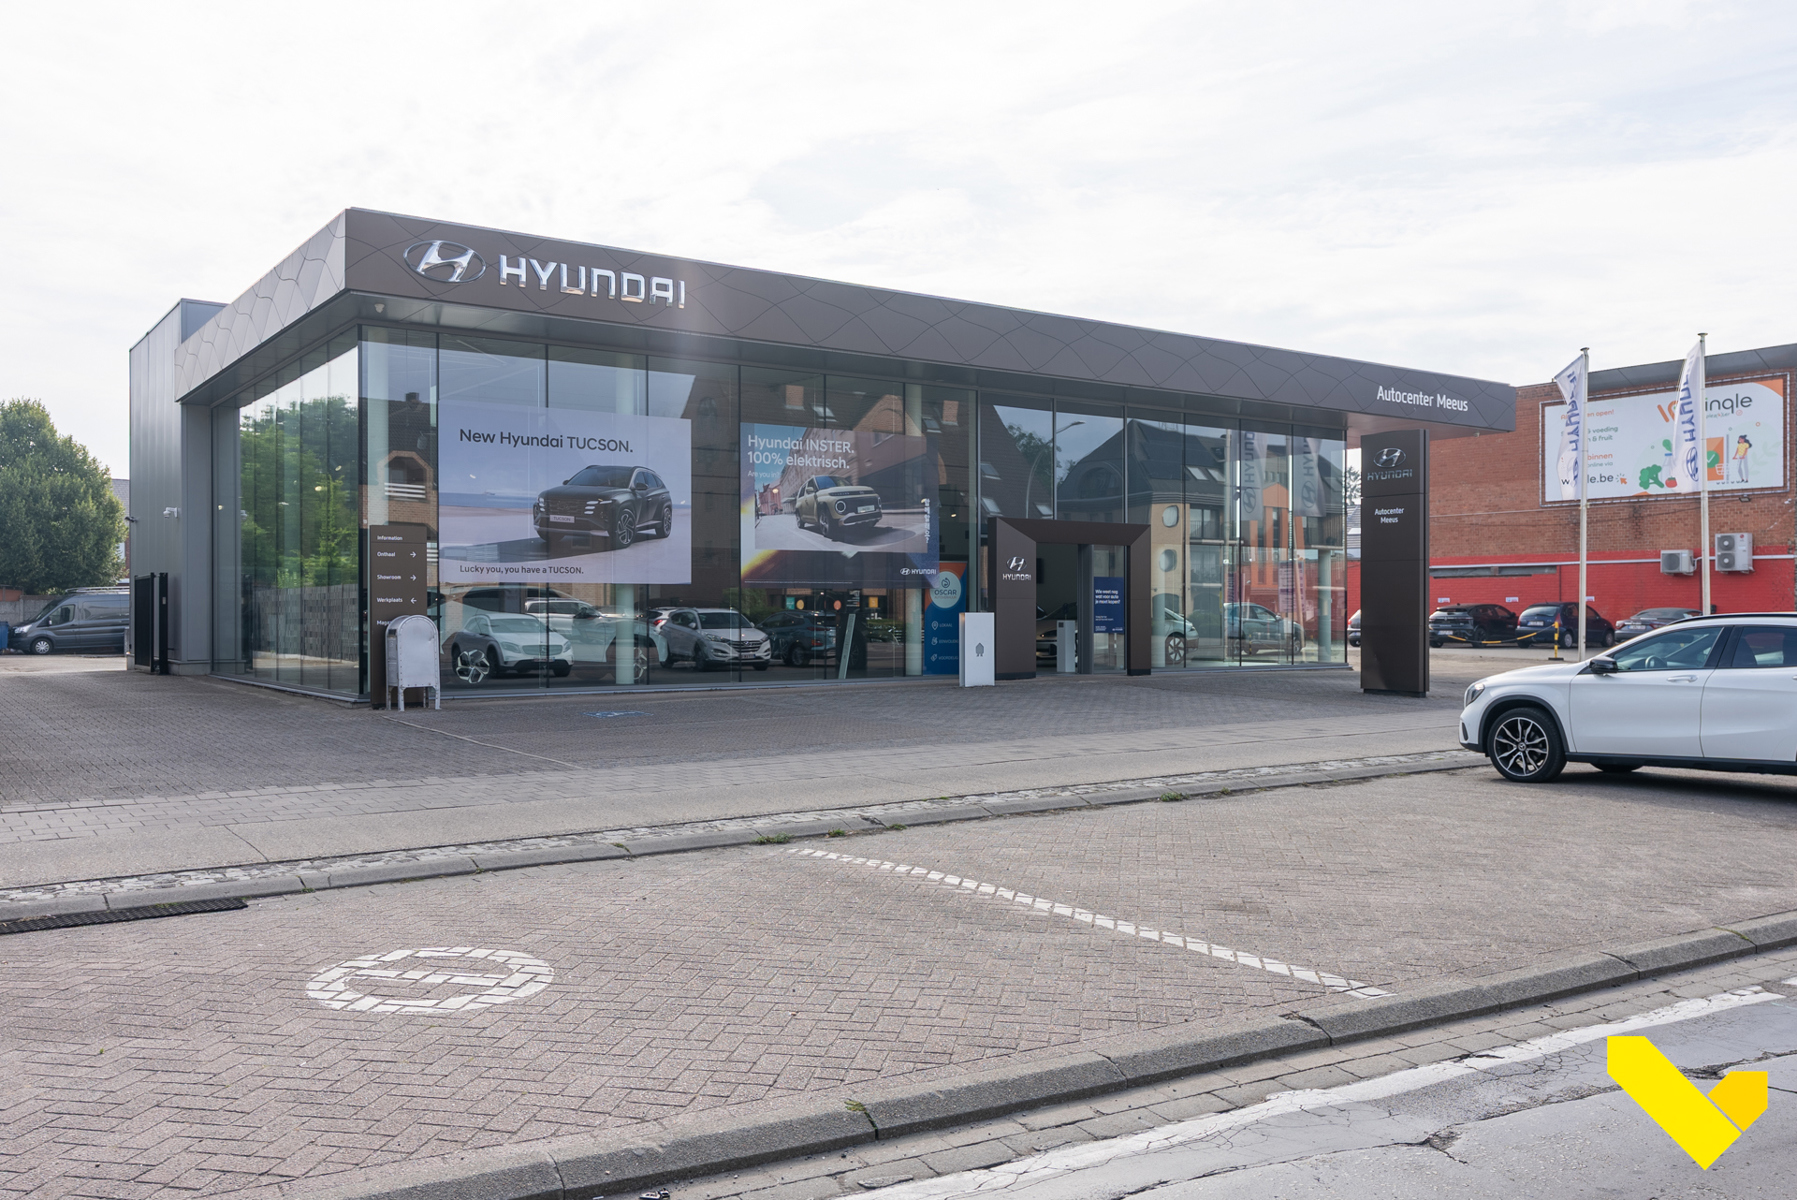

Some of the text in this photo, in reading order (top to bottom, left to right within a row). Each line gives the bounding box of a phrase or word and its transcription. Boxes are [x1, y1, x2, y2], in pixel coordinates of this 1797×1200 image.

[499, 254, 685, 309] HYUNDAI
[1377, 385, 1469, 412] Autocenter Meeus
[459, 428, 634, 453] New Hyundai TUCSON.
[747, 435, 855, 454] Hyundai INSTER.
[747, 451, 850, 469] 100% elektrisch.
[1367, 469, 1413, 481] HYUNDAI
[1374, 507, 1405, 516] Autocenter
[1380, 516, 1398, 524] Meeus
[460, 565, 484, 574] Lucky
[485, 566, 503, 574] you,
[504, 566, 520, 575] you
[521, 566, 541, 574] have
[548, 566, 584, 574] TUCSON.
